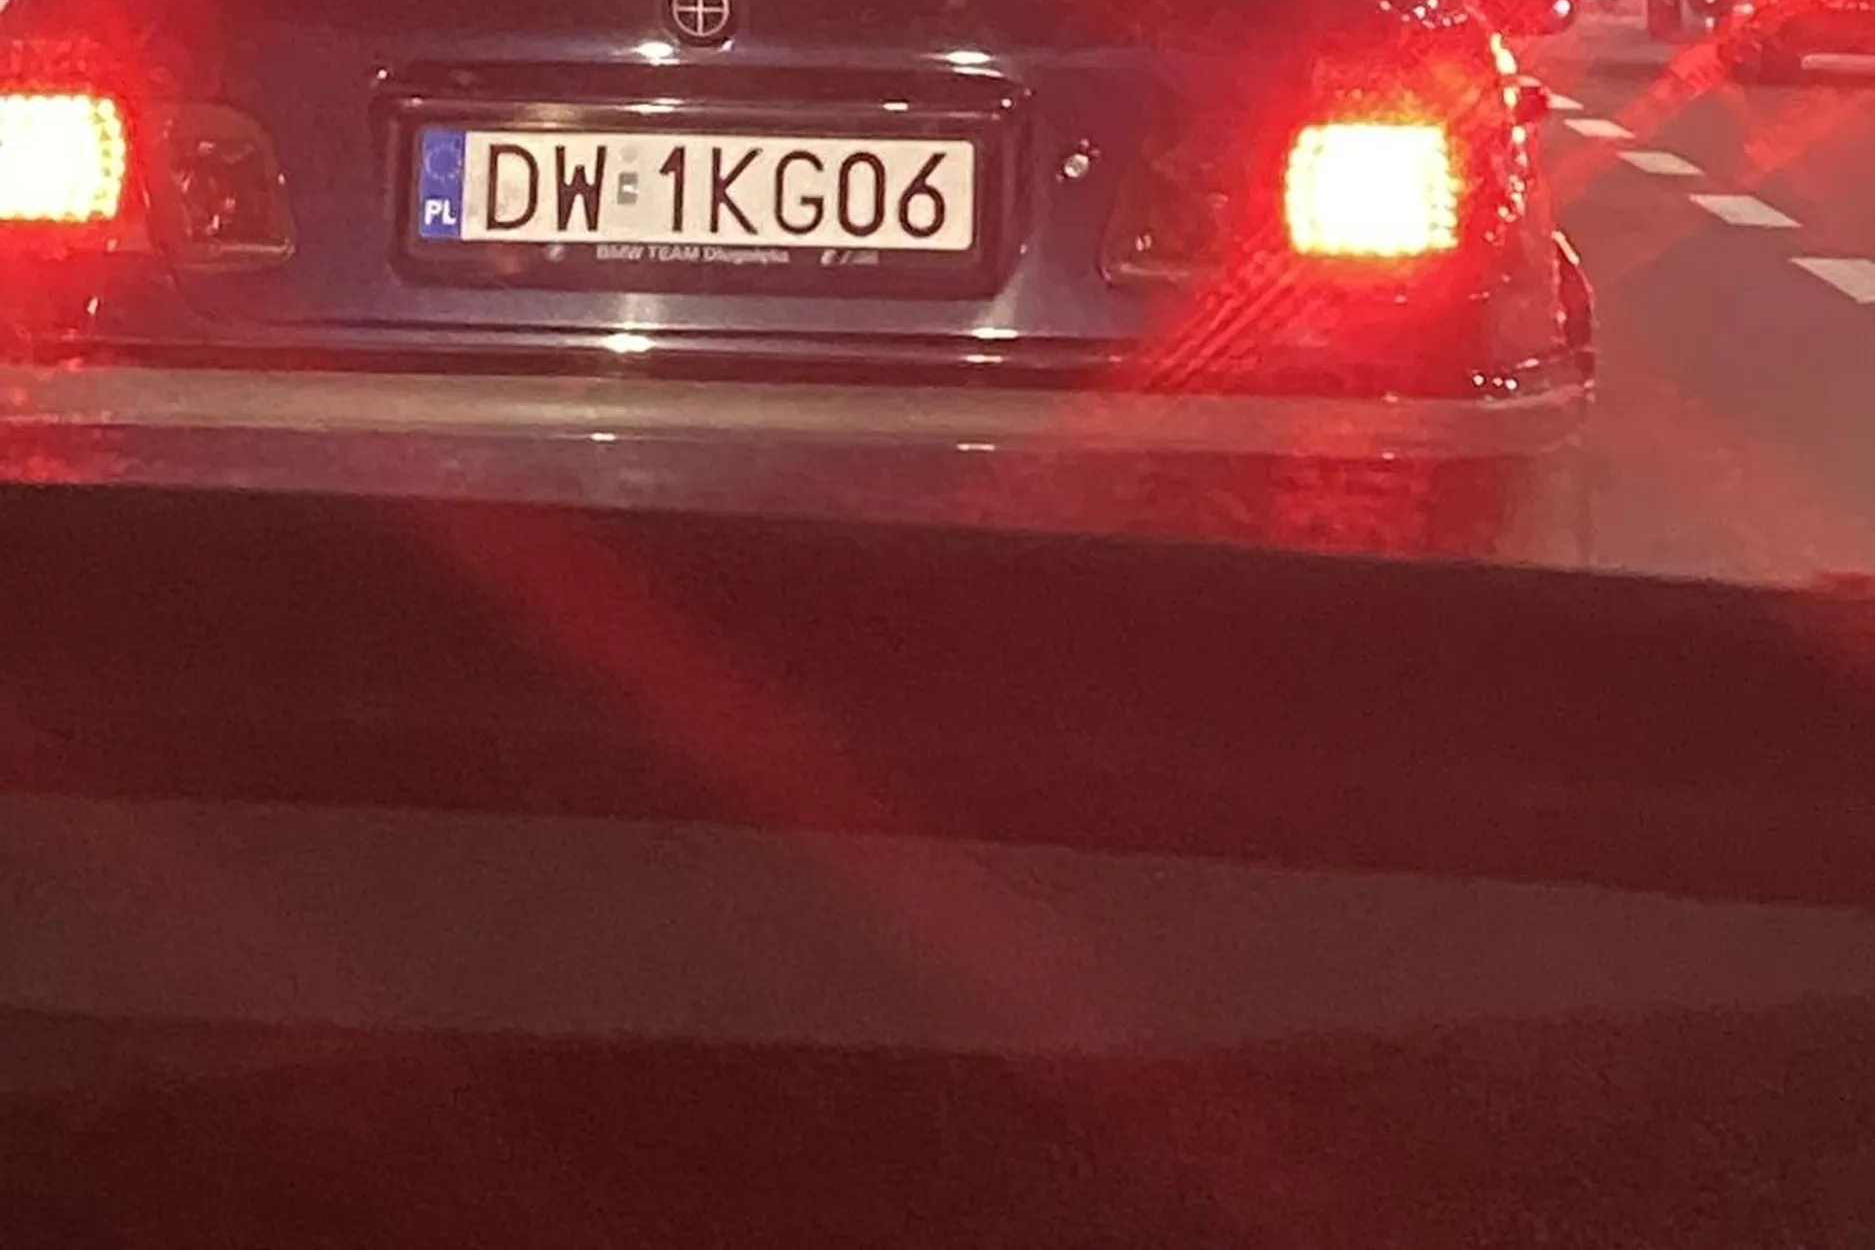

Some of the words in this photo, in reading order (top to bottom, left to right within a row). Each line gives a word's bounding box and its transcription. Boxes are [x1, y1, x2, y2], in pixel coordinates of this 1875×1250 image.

[486, 143, 605, 232] DW
[659, 145, 947, 237] 1KG06
[425, 201, 457, 226] PL
[596, 244, 642, 260] BMW
[648, 246, 700, 262] TEAM
